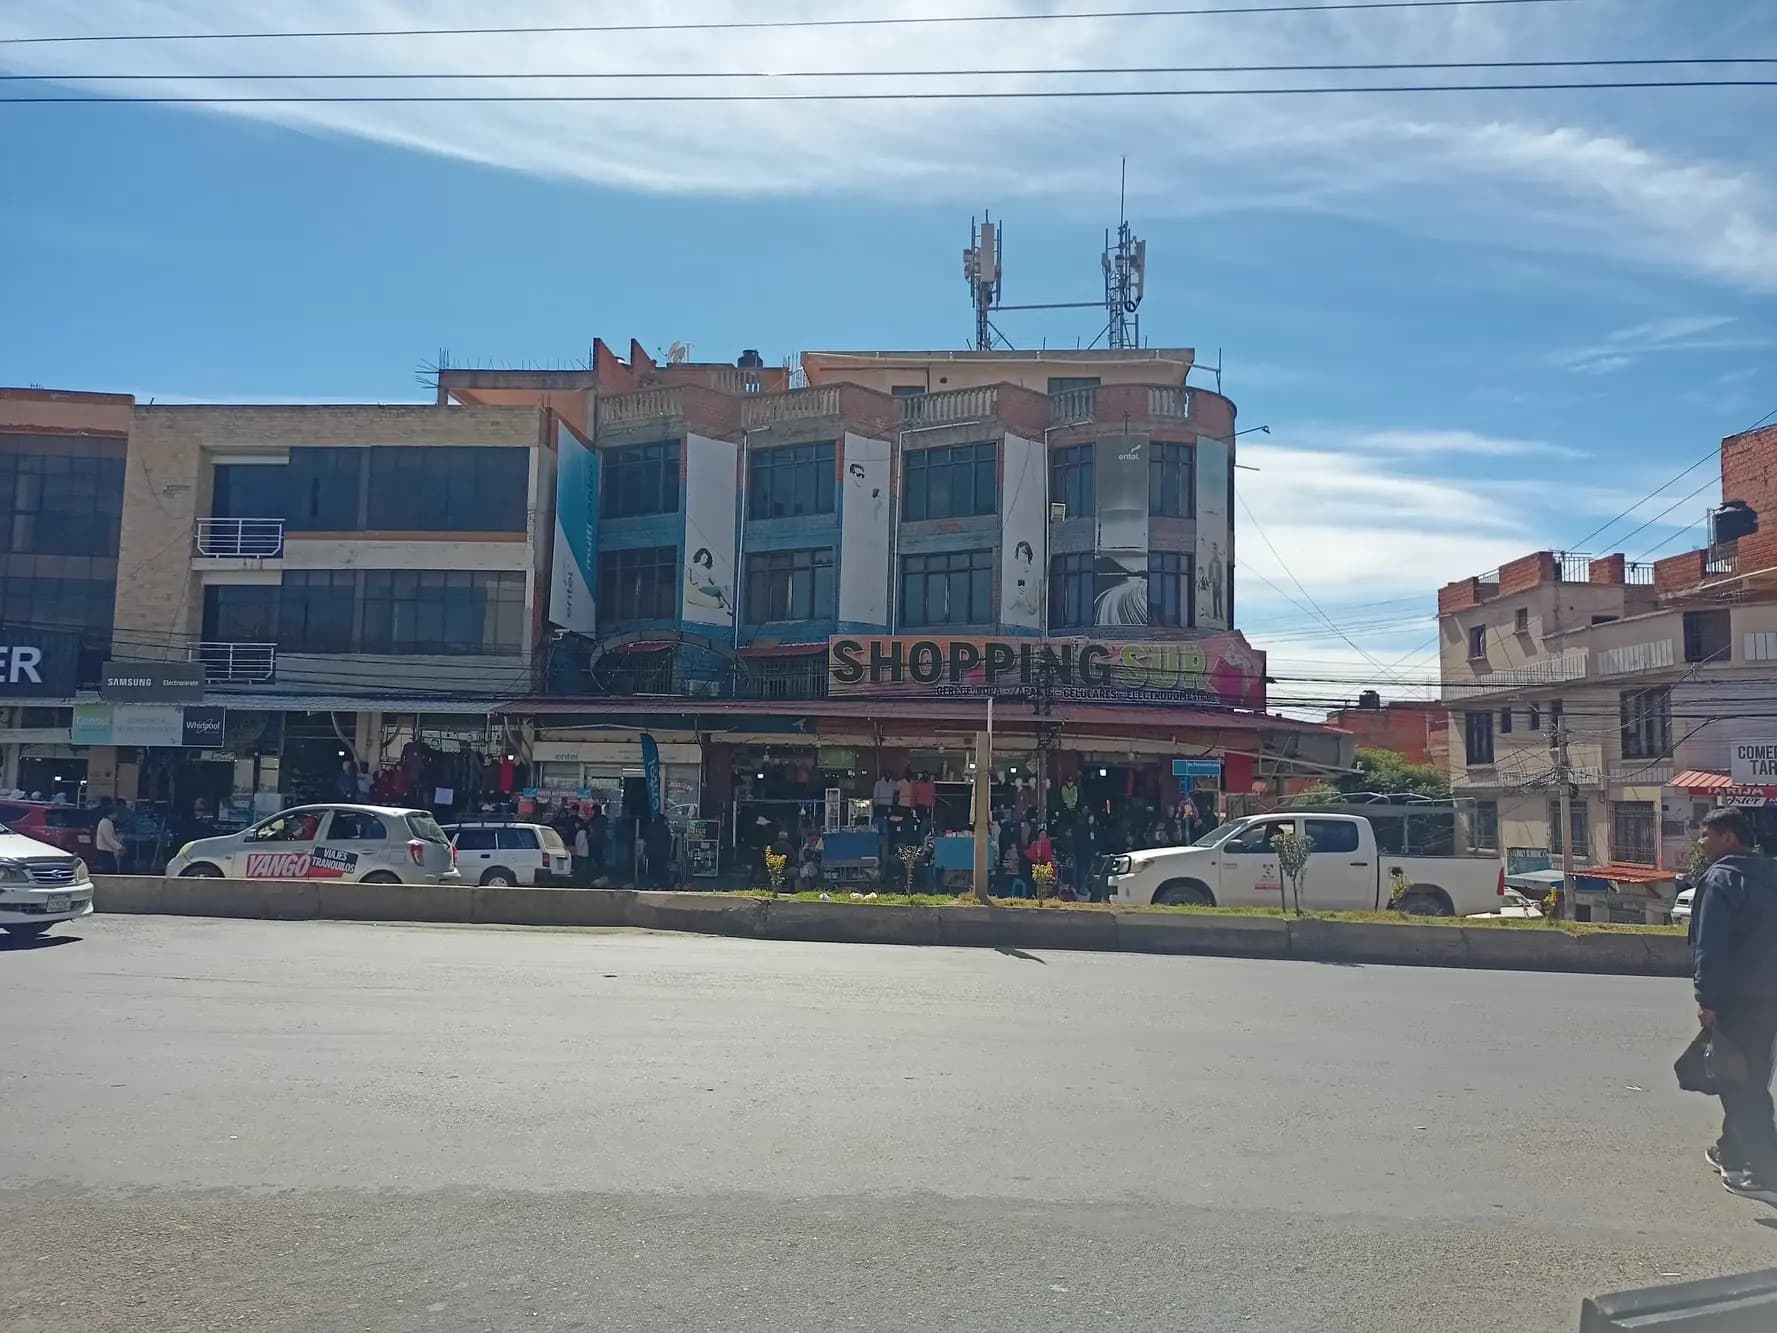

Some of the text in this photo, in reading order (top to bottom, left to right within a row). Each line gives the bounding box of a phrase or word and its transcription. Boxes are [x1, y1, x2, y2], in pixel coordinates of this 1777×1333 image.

[1119, 452, 1139, 460] entel
[566, 572, 574, 619] entel
[831, 639, 1206, 689] SHOPPING SUR
[107, 678, 152, 687] SAMSUNG
[186, 720, 220, 731] Whirlpool
[555, 751, 579, 761] entel
[647, 759, 659, 811] entel
[324, 848, 348, 861] VIAJES
[248, 855, 310, 877] YANGO
[312, 856, 356, 873] TRANQUILOS
